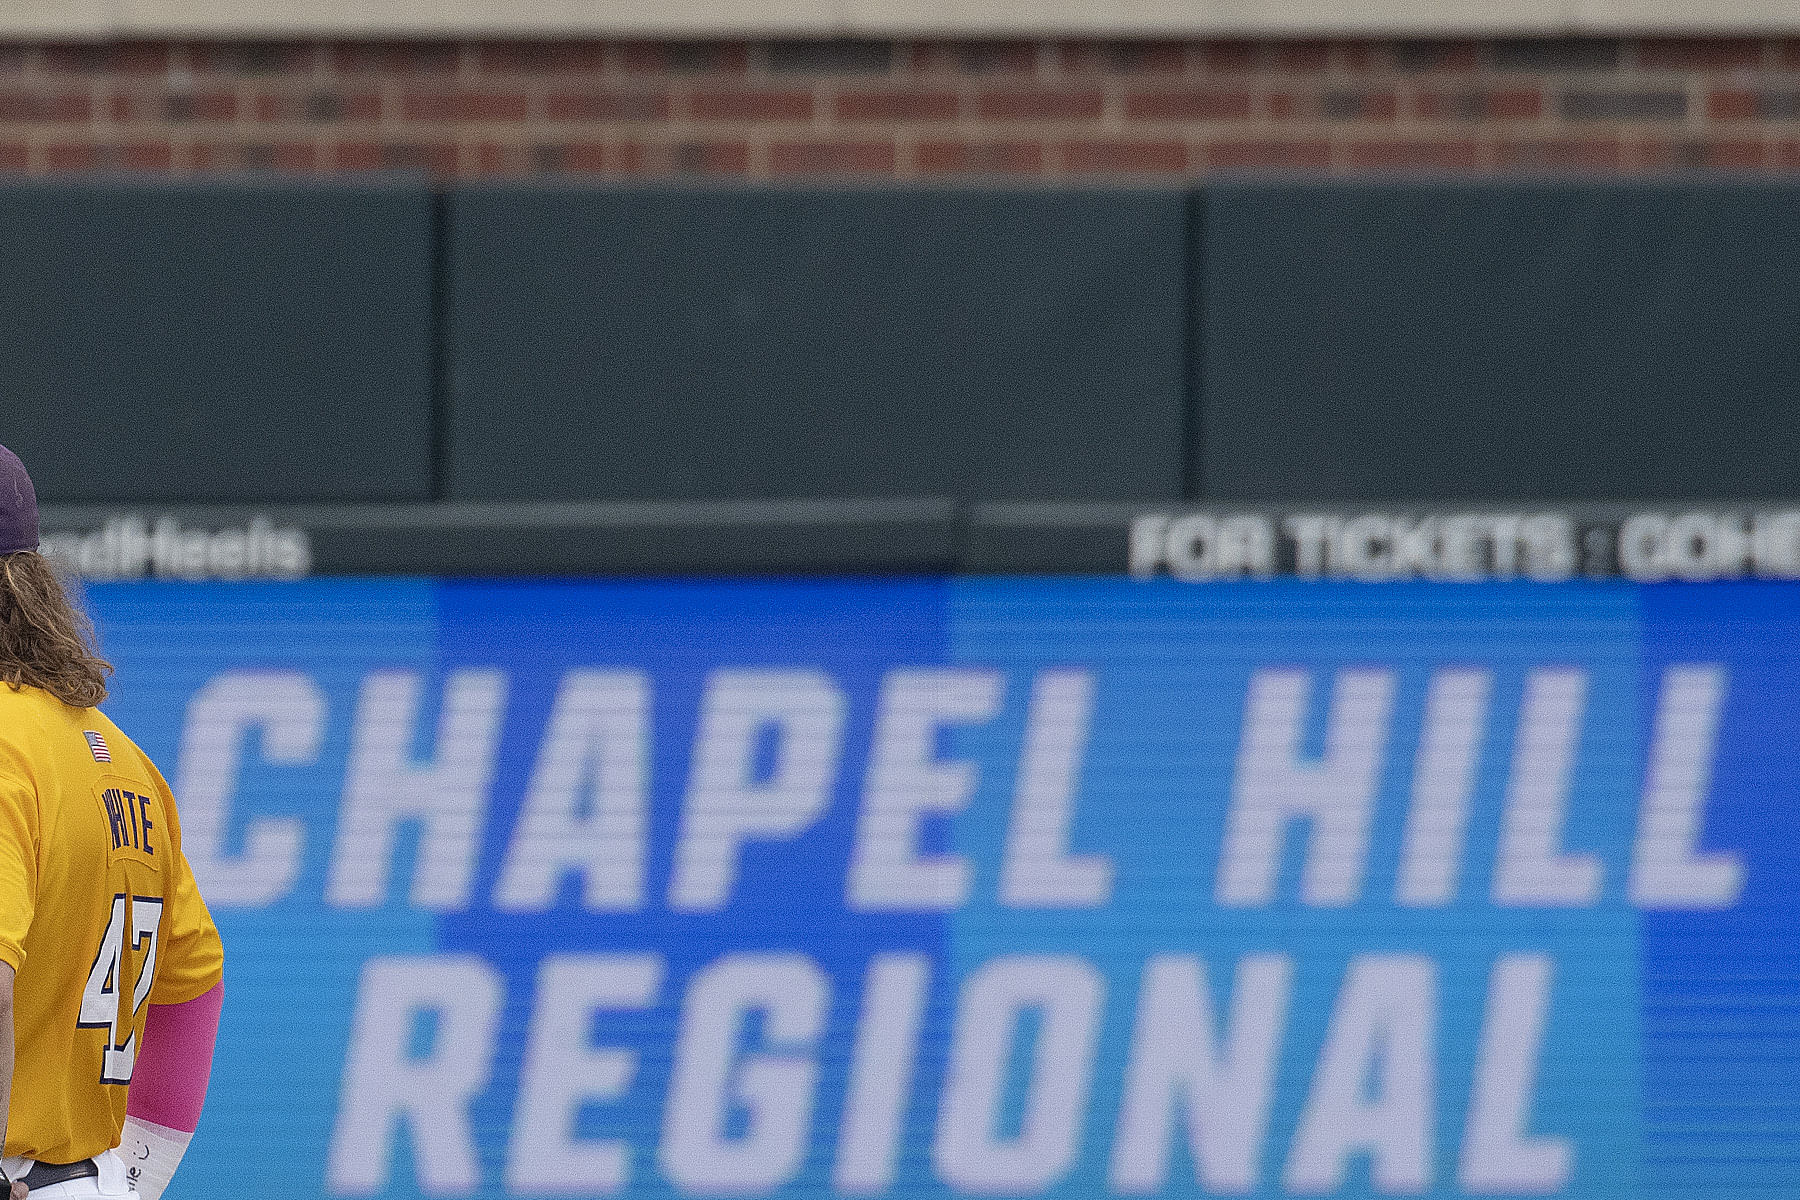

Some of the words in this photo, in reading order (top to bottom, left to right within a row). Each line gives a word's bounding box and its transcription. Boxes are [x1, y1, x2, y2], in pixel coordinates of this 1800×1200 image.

[1128, 513, 1276, 580] FOR
[1286, 513, 1576, 580] TICKETS
[175, 669, 1112, 906] CHAPEL
[1216, 669, 1742, 906] HILL
[76, 893, 163, 1085] 47
[327, 953, 1572, 1195] REGIONAL
